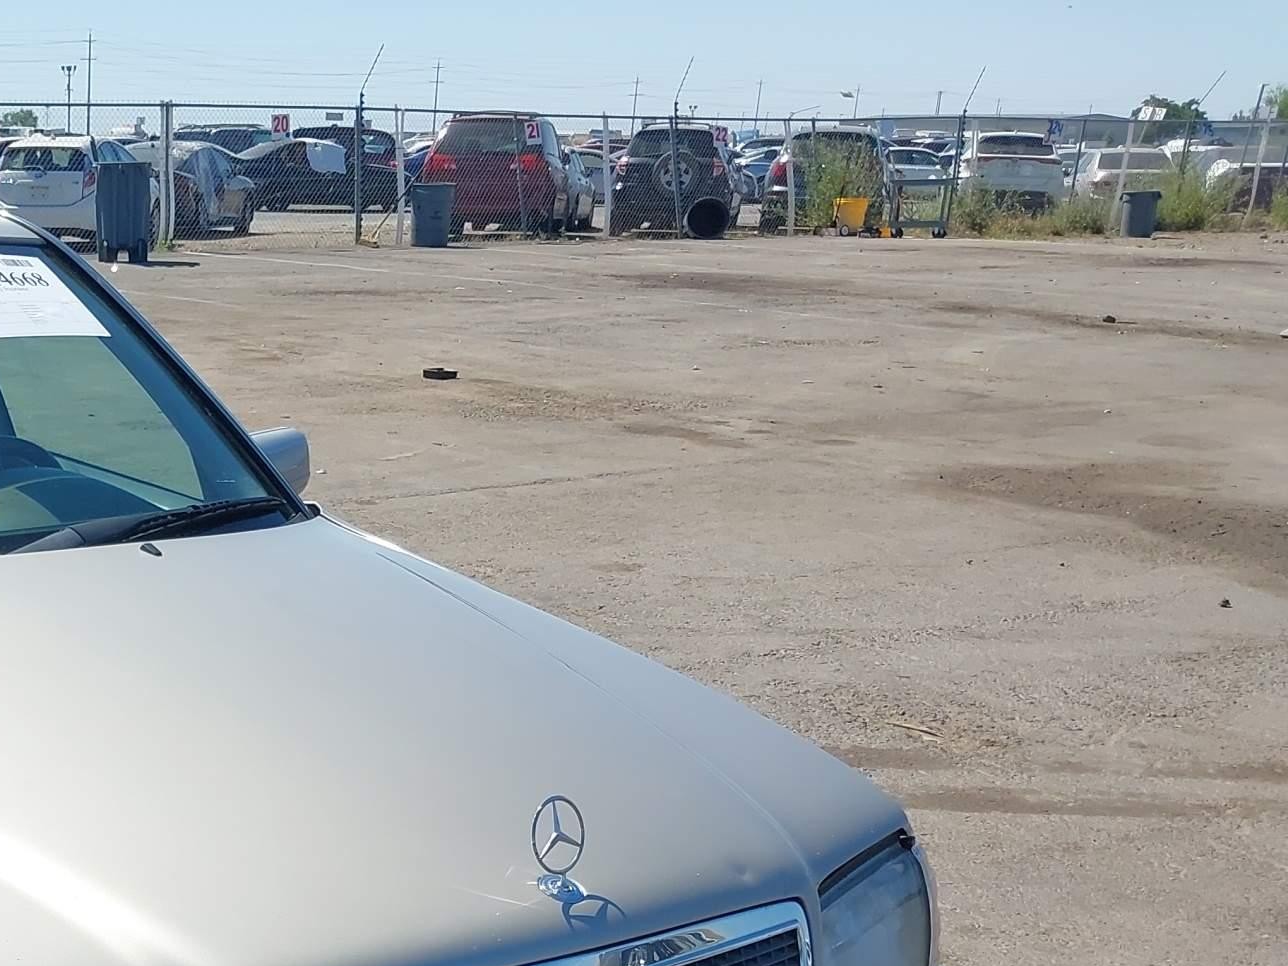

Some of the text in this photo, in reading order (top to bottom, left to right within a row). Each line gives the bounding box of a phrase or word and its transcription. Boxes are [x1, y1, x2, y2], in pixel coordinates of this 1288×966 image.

[273, 116, 289, 133] 20
[526, 123, 540, 139] 21
[715, 127, 727, 142] 22
